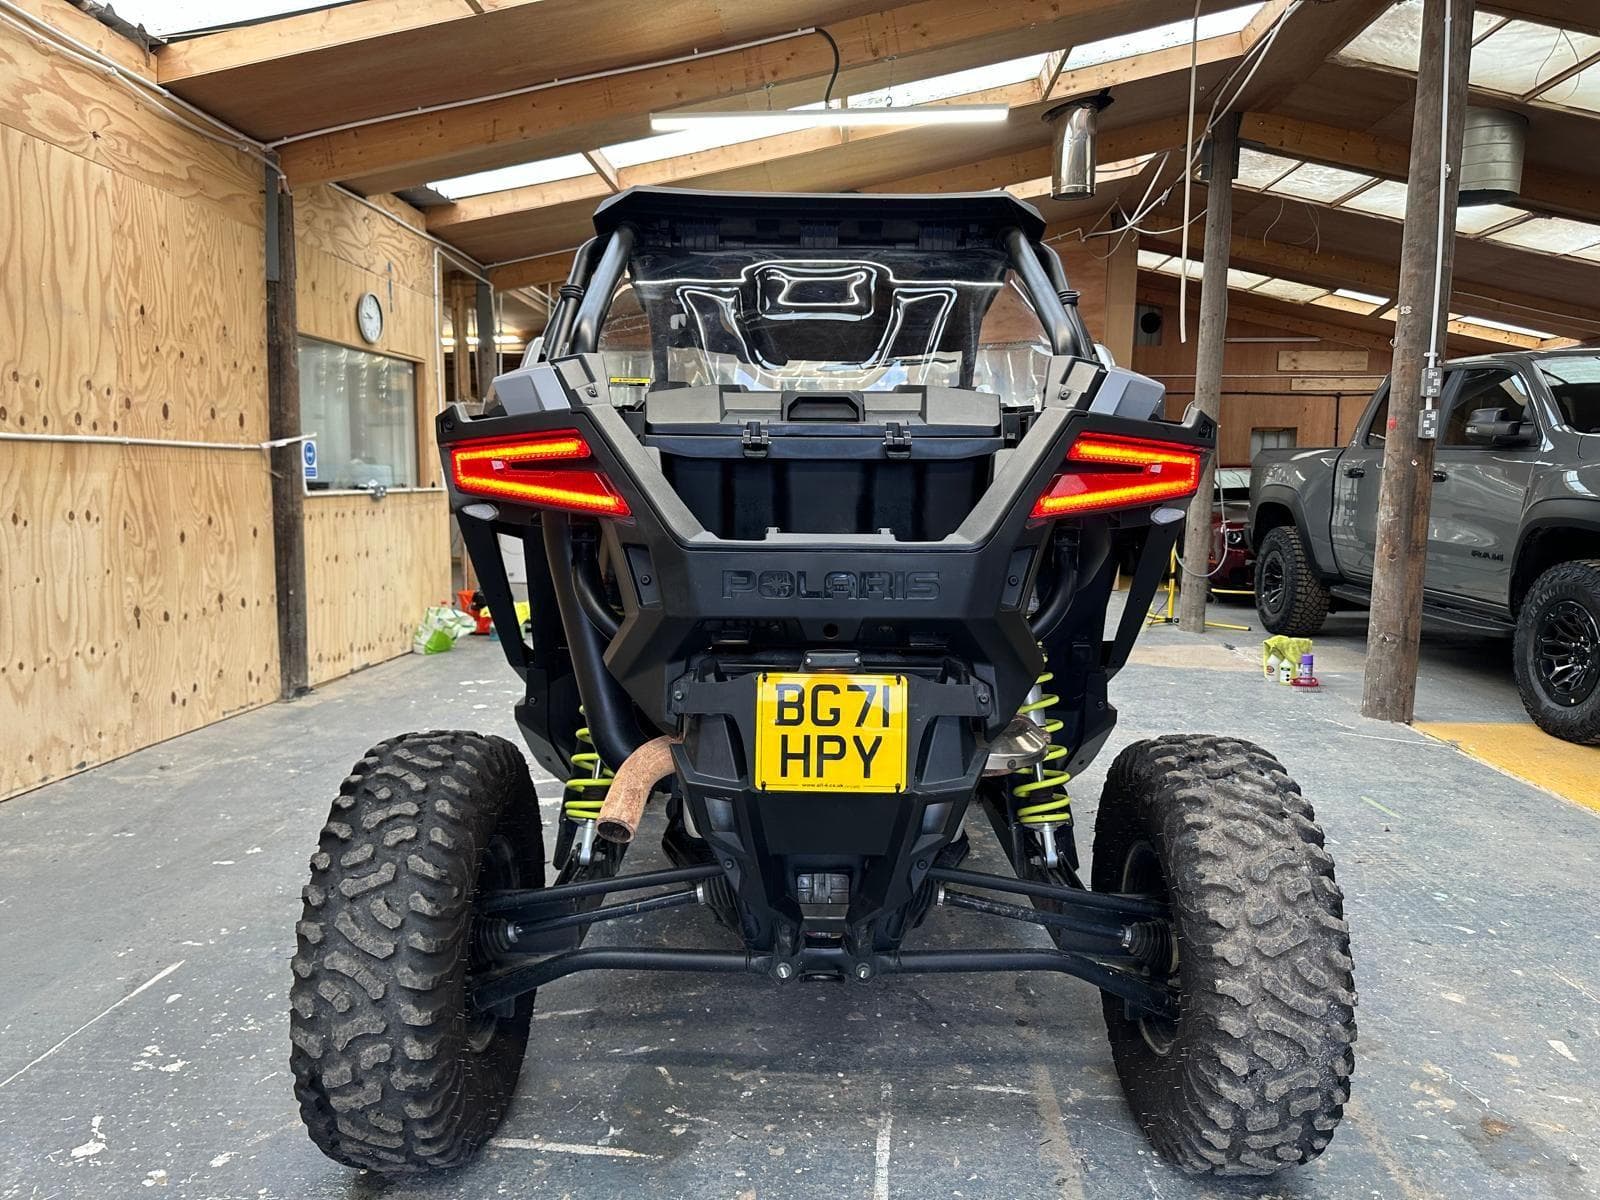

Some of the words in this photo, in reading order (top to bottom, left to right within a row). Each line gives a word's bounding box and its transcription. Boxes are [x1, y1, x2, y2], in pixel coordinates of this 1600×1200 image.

[1471, 549, 1504, 562] RAM
[721, 569, 942, 601] POLARIS
[775, 683, 890, 728] BG71
[780, 734, 883, 779] HPY
